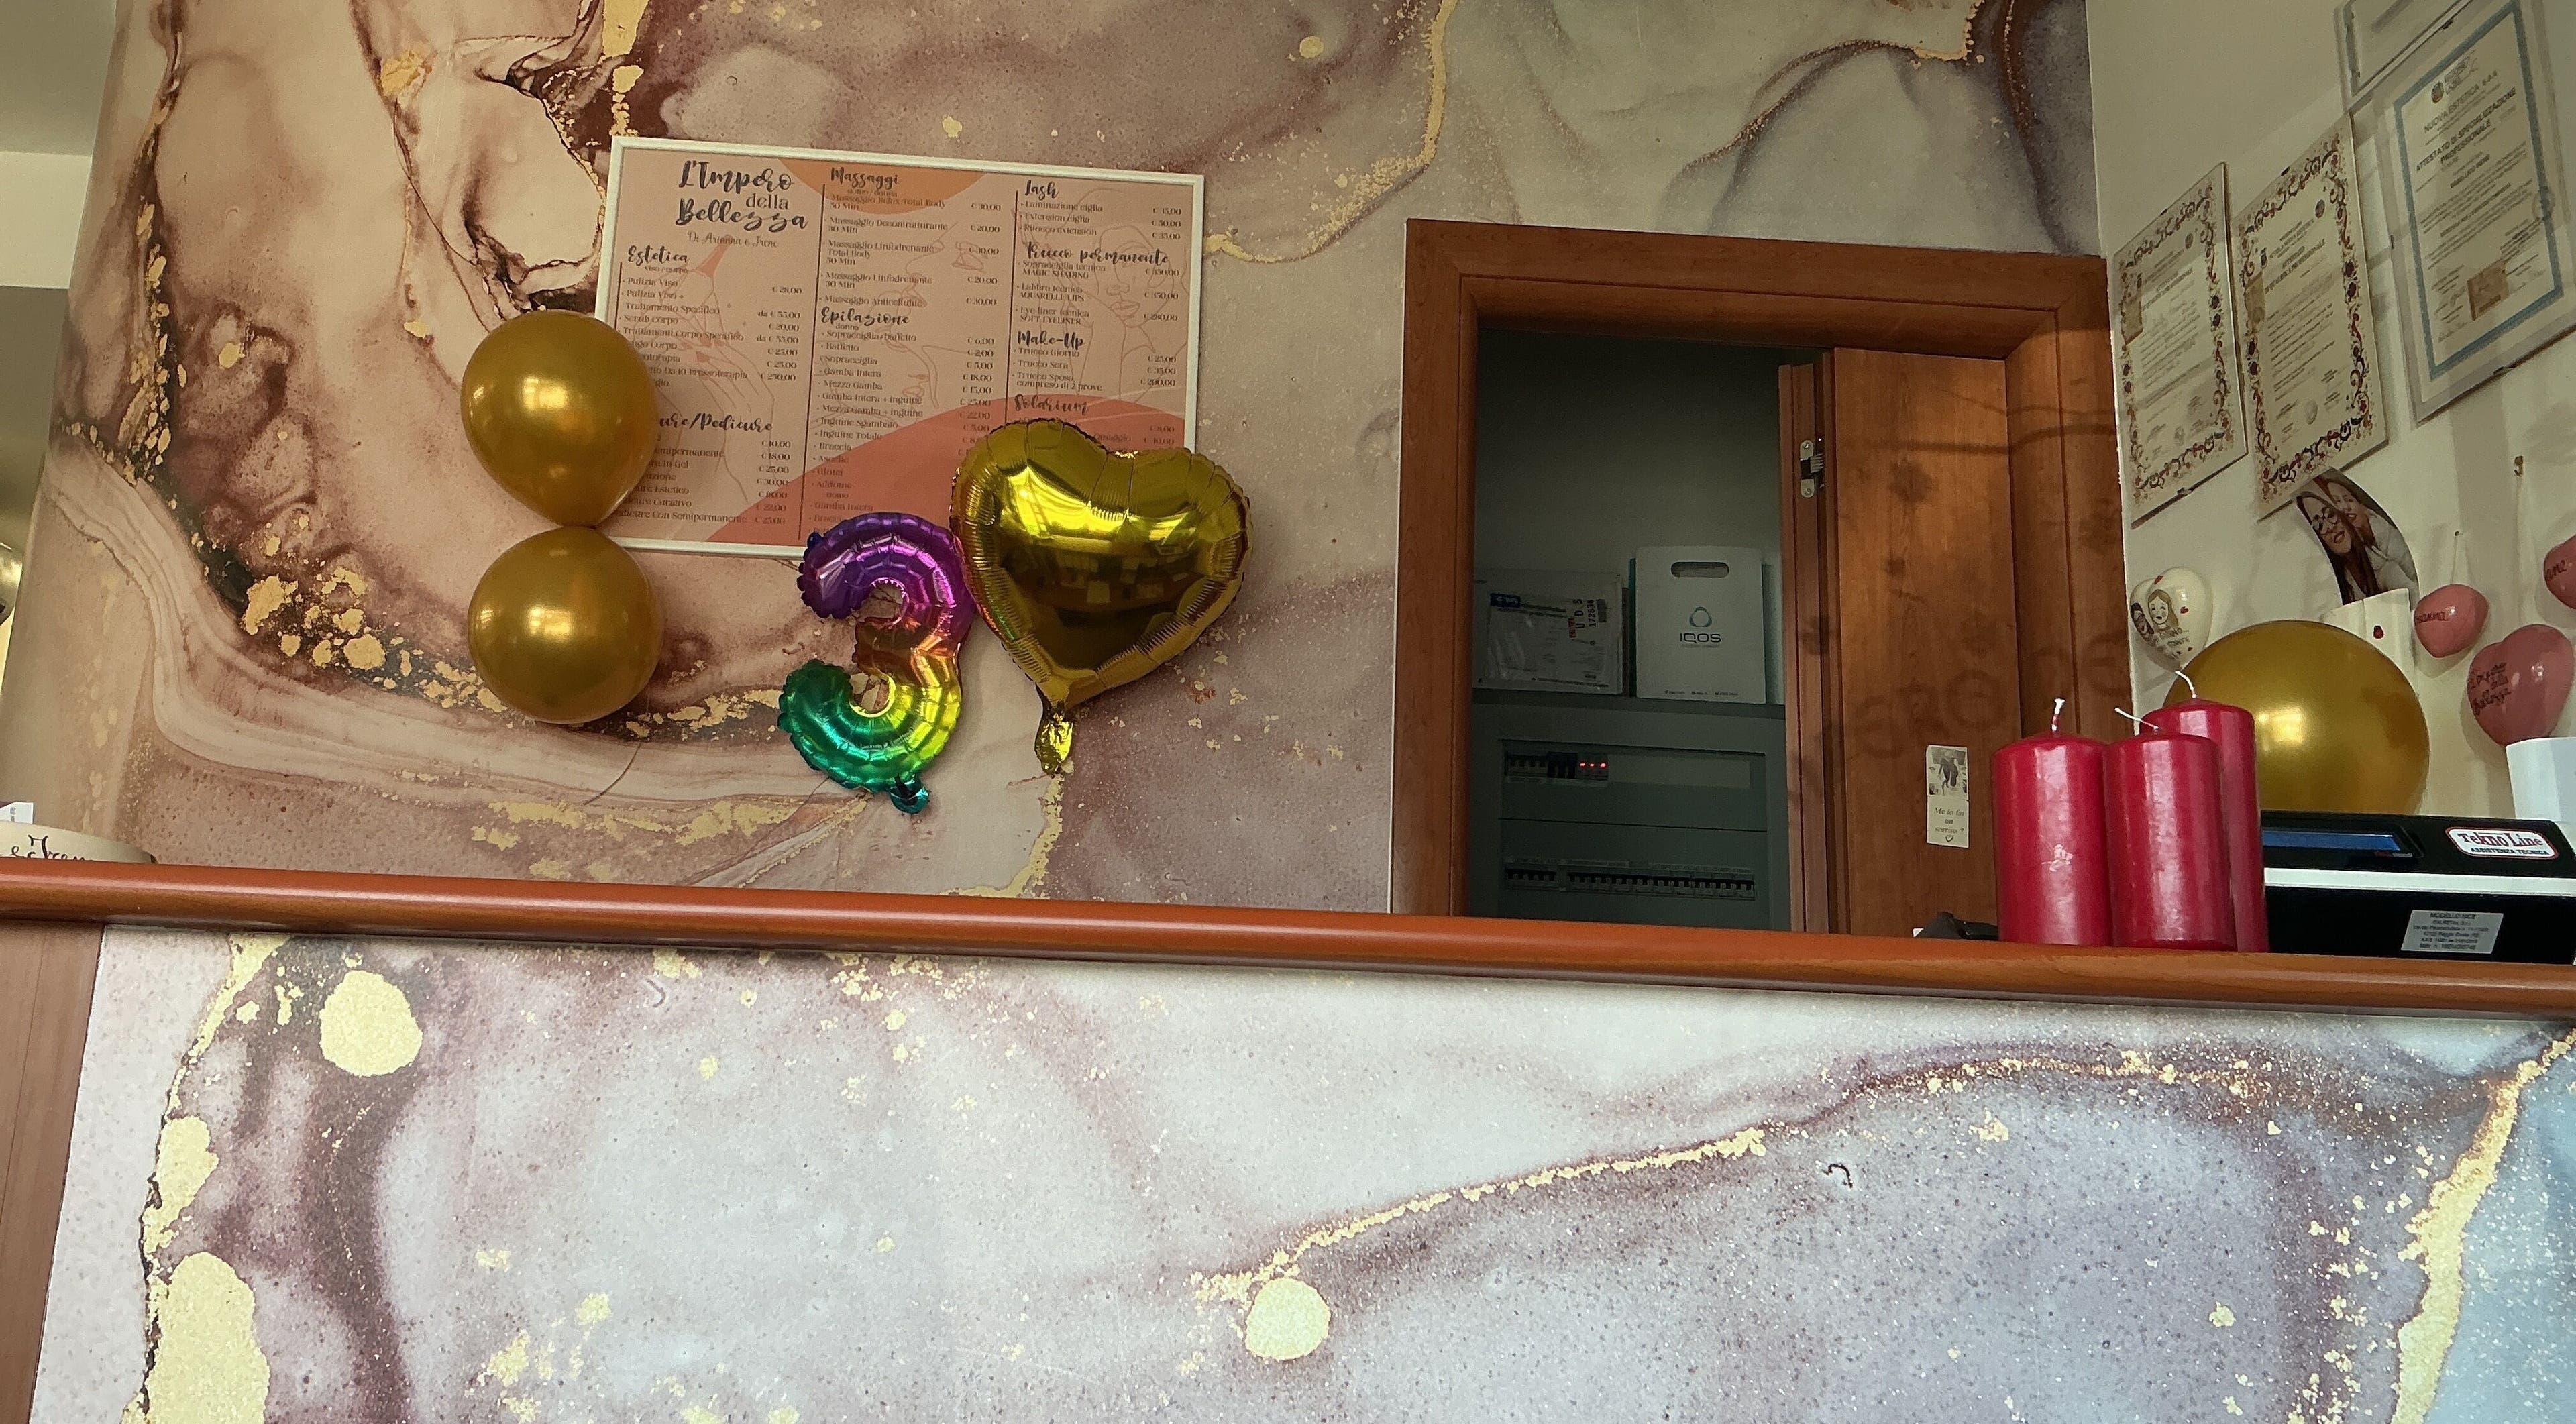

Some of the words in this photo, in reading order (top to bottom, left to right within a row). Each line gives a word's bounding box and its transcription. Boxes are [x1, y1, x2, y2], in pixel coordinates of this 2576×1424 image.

[2415, 139, 2449, 173] ATTESTATO
[679, 160, 794, 194] L'Impero
[830, 166, 899, 190] Massaggi
[1024, 179, 1060, 201] Lash
[746, 193, 790, 210] della
[676, 198, 808, 233] Bellezza
[628, 245, 689, 266] Estetica
[1079, 247, 1171, 266] permanente
[820, 305, 910, 327] Epilazione
[1017, 330, 1084, 351] Make-Up
[1014, 394, 1088, 415] Solarium
[659, 412, 773, 433] ure/Pedicure
[1680, 633, 1721, 644] IQOS
[2457, 832, 2510, 847] Tekno
[2507, 833, 2543, 846] Line
